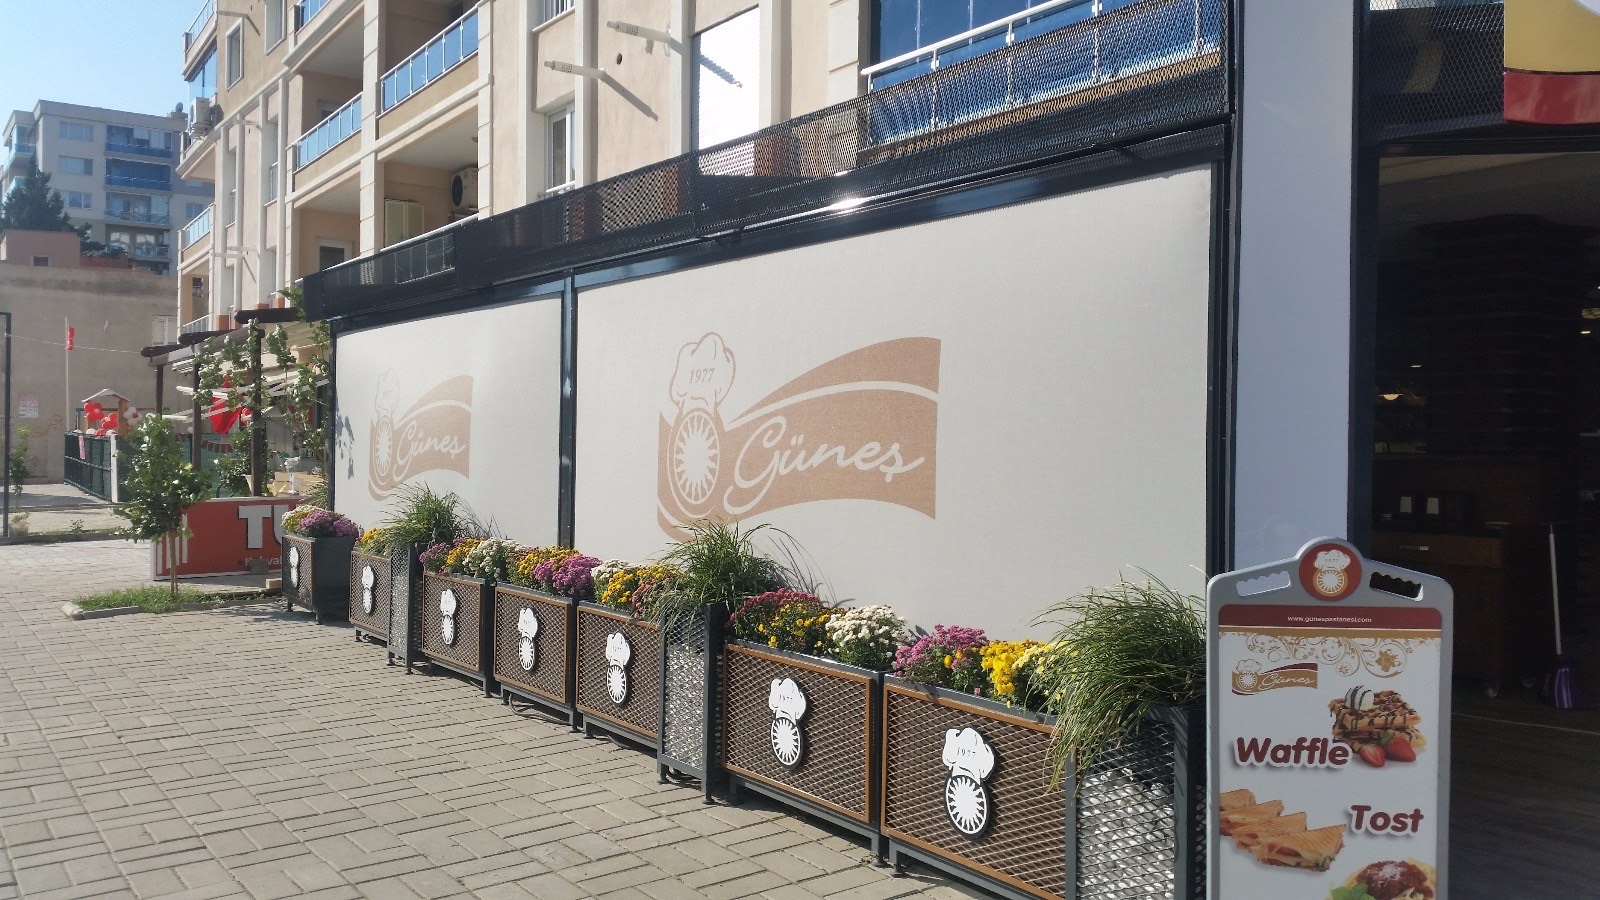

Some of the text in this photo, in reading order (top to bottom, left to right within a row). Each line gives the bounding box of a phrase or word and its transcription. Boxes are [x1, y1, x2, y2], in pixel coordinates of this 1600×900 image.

[689, 368, 715, 384] 1977
[393, 420, 466, 482] Güneş
[723, 415, 924, 514] Güneş
[956, 746, 976, 759] 1977
[1236, 737, 1350, 766] Waffle
[1351, 805, 1424, 833] Tost
